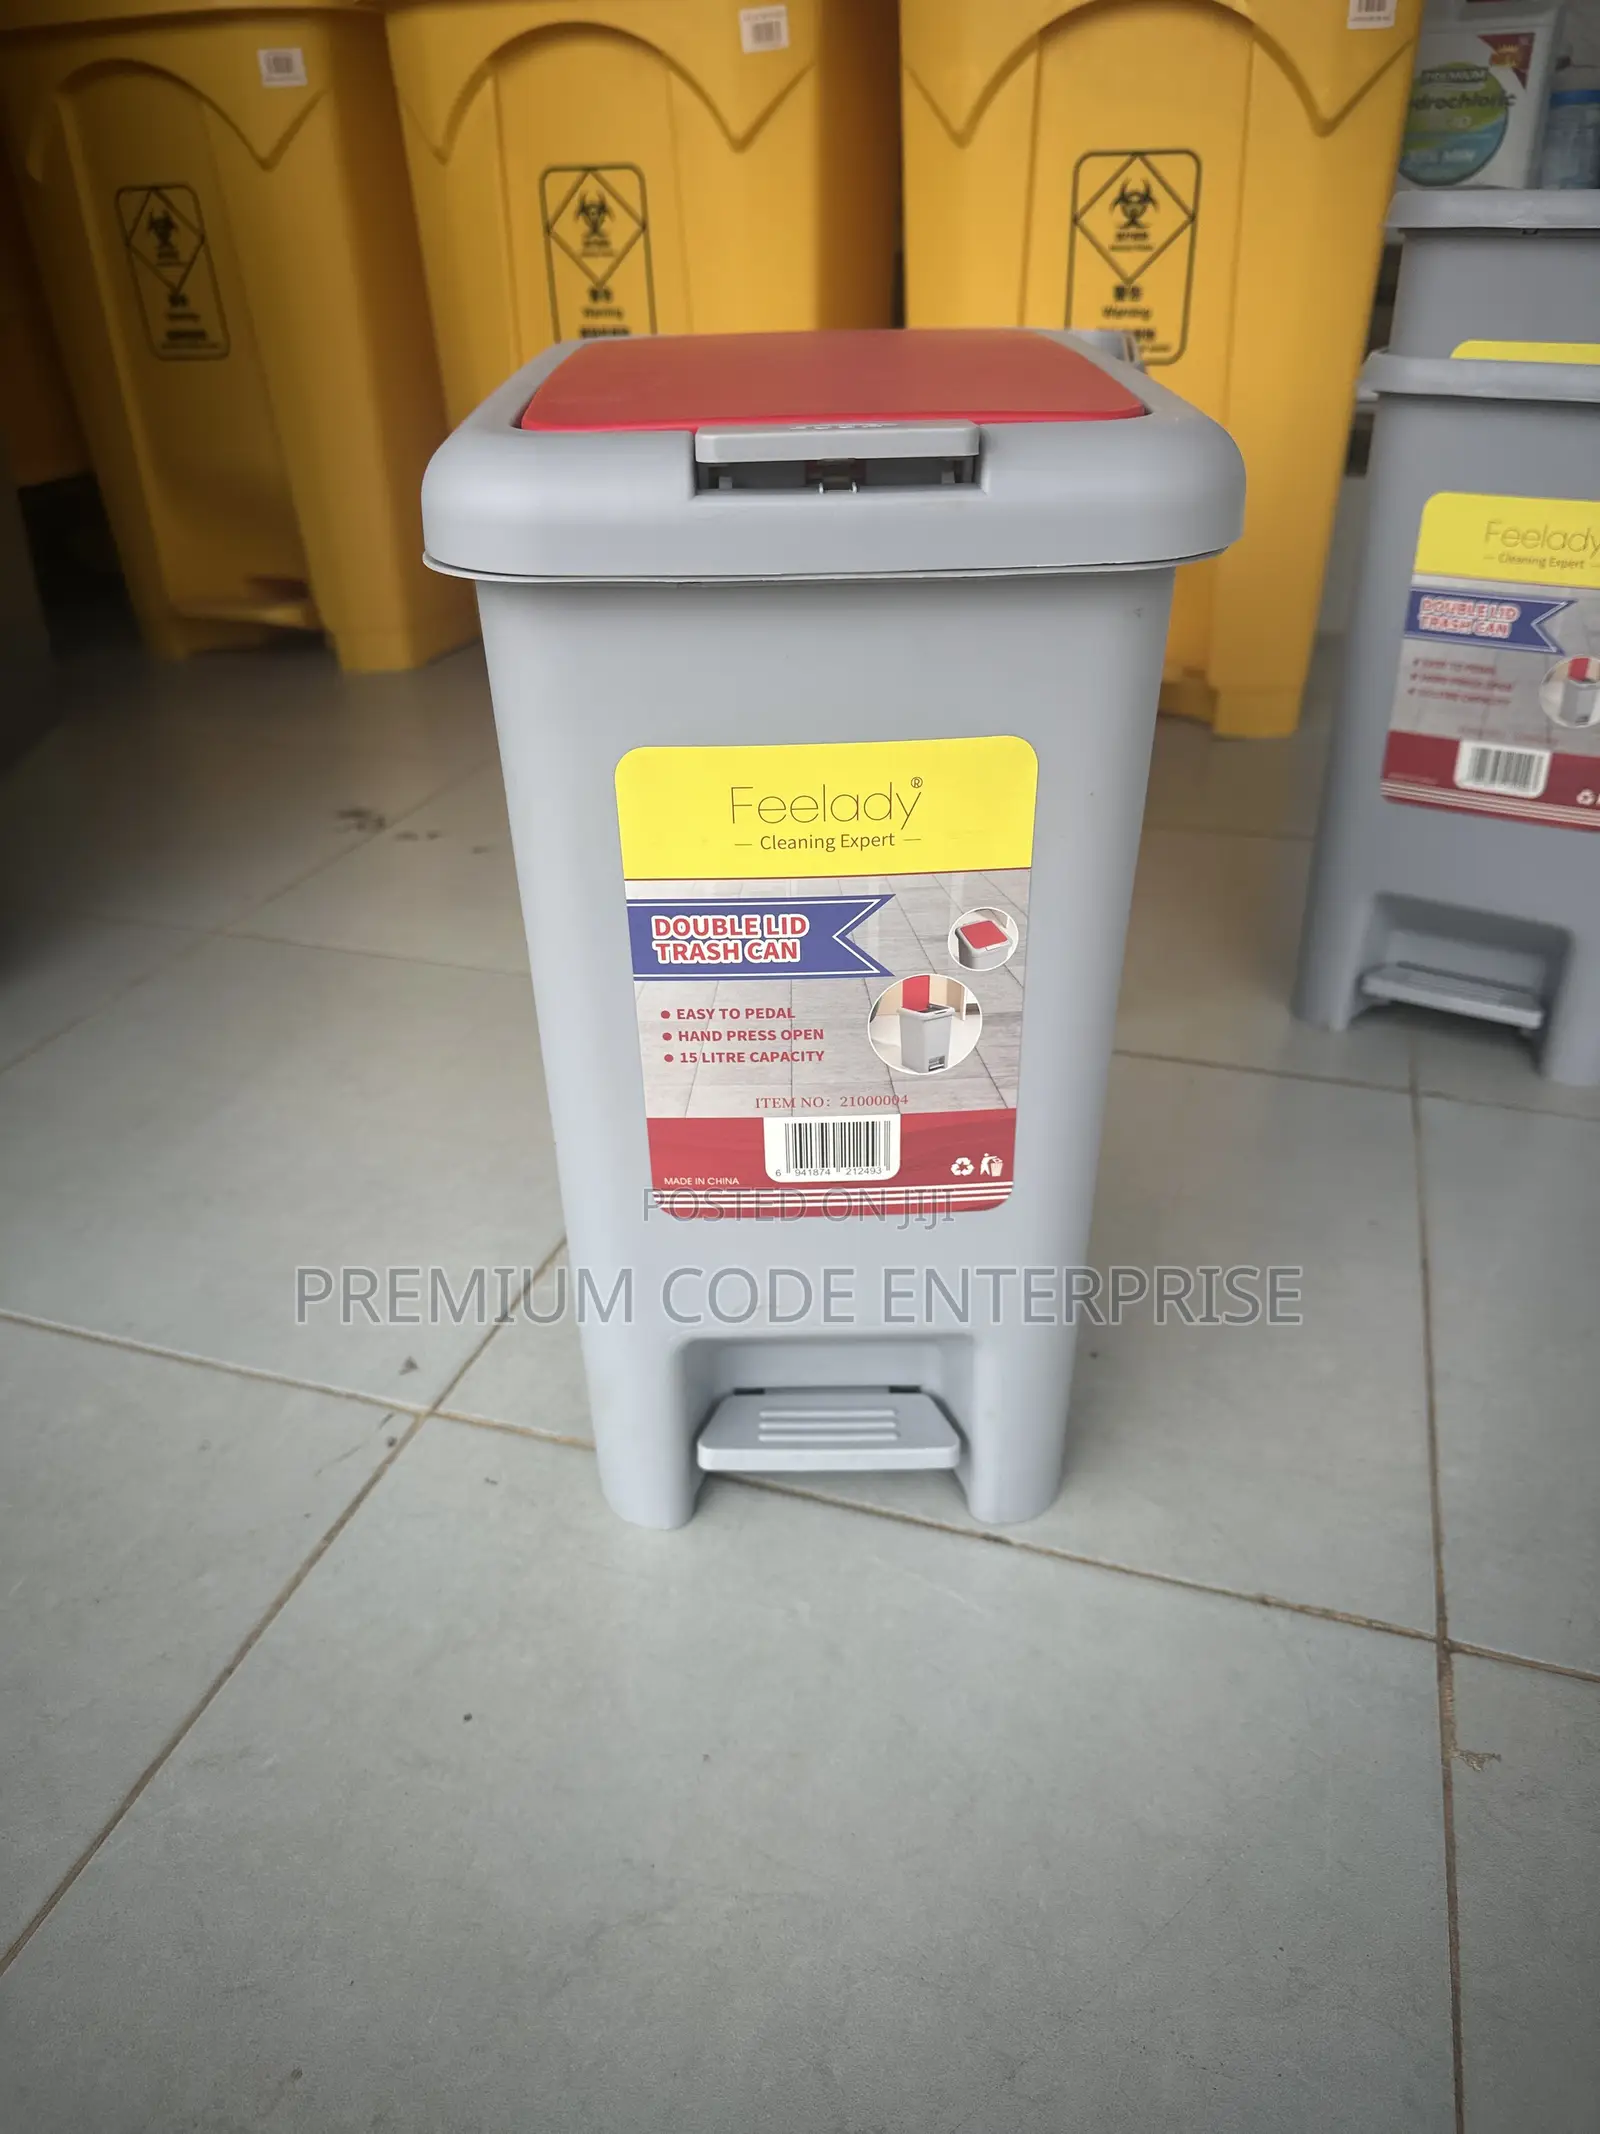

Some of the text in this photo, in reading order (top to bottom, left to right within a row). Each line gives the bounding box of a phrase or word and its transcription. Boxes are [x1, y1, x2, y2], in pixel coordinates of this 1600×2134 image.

[1497, 552, 1585, 571] Cleaning Expert
[760, 832, 896, 853] Cleaning Expert
[653, 915, 808, 938] DOUBLE LID
[656, 939, 799, 963] TRASH CAN
[676, 1007, 796, 1021] EASY TO PEDAL
[678, 1028, 824, 1043] HAND PRESS OPEN
[680, 1050, 825, 1064] 15 LITRE CAPACITY
[755, 1097, 796, 1110] ITEM
[839, 1094, 909, 1108] 21000004
[775, 1166, 882, 1178] 6 941874 212493
[664, 1177, 740, 1186] MADE IN CHINA
